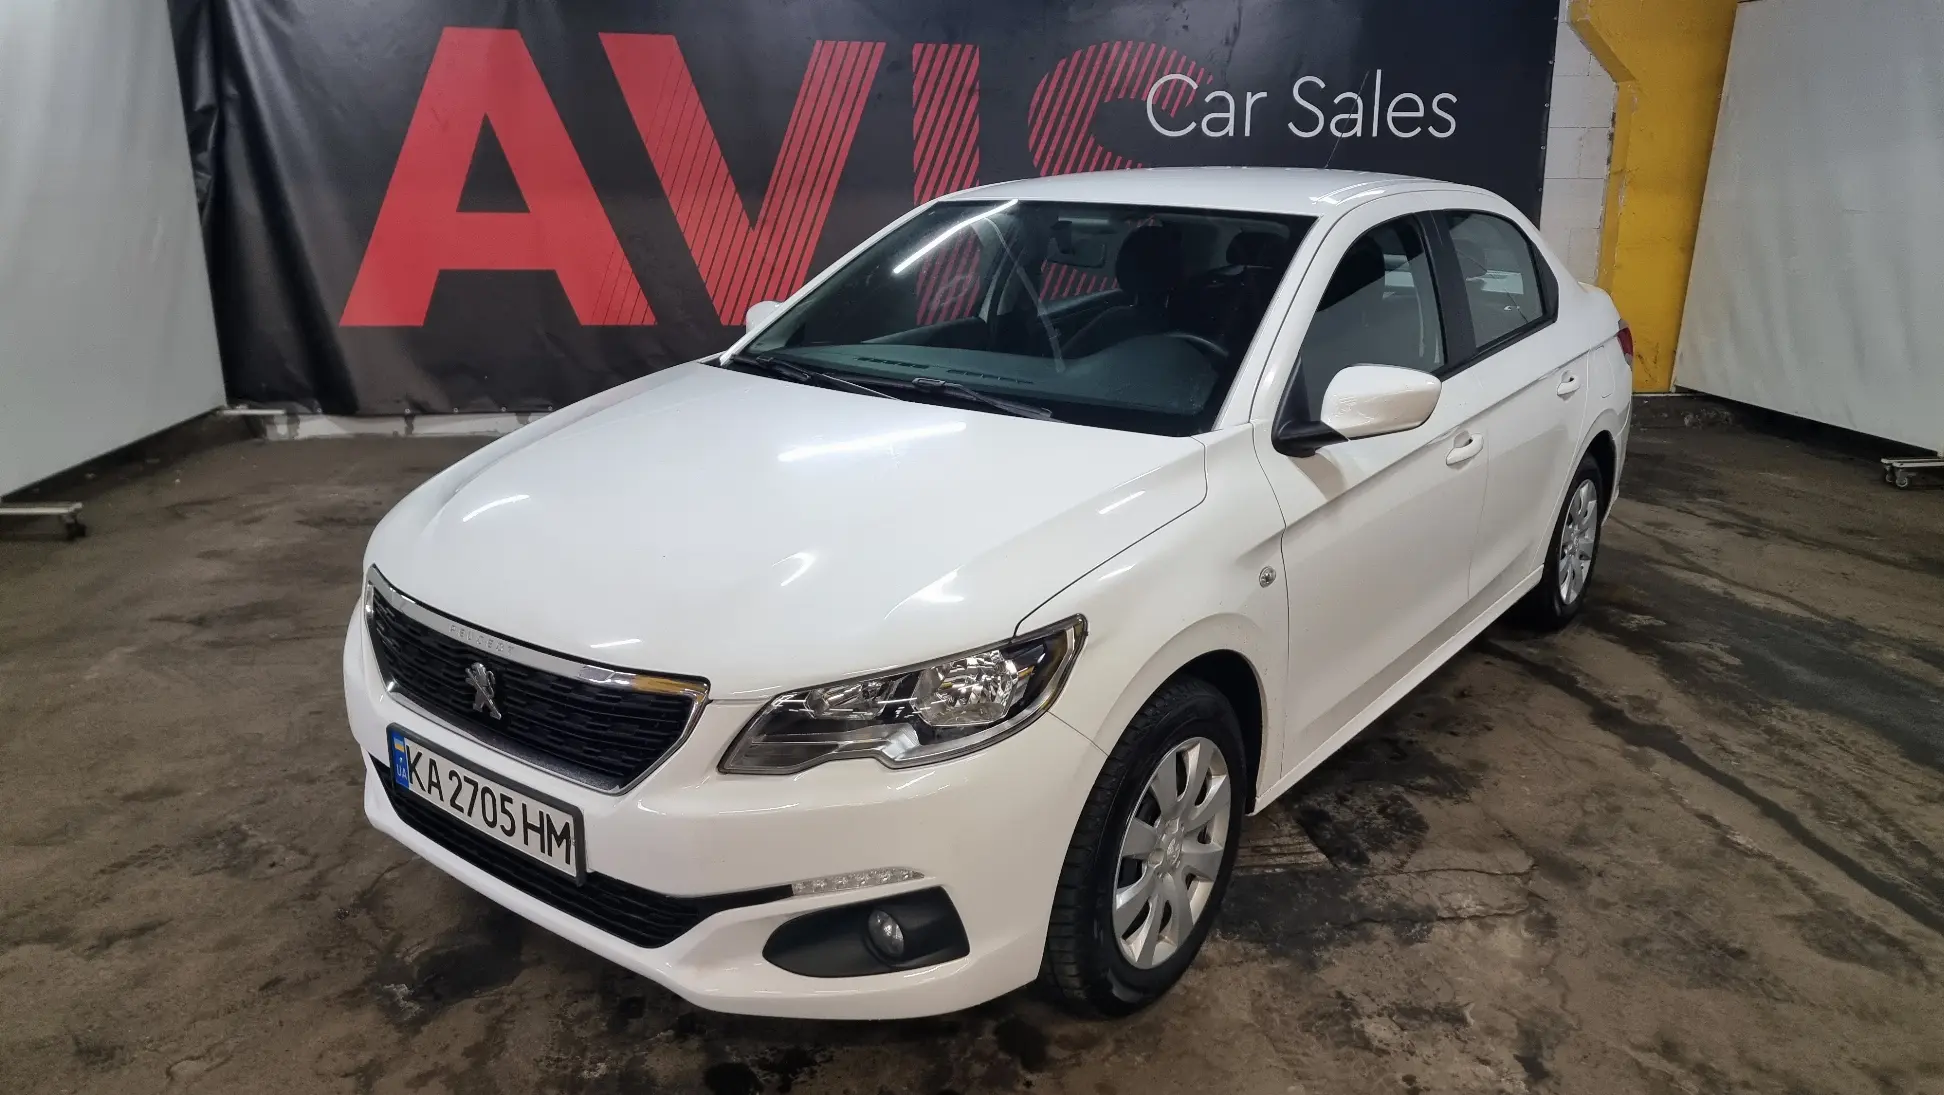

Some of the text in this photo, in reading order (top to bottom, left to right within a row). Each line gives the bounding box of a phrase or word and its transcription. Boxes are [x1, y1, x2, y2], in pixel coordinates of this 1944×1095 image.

[1146, 69, 1458, 138] Car Sales
[396, 764, 408, 780] UA
